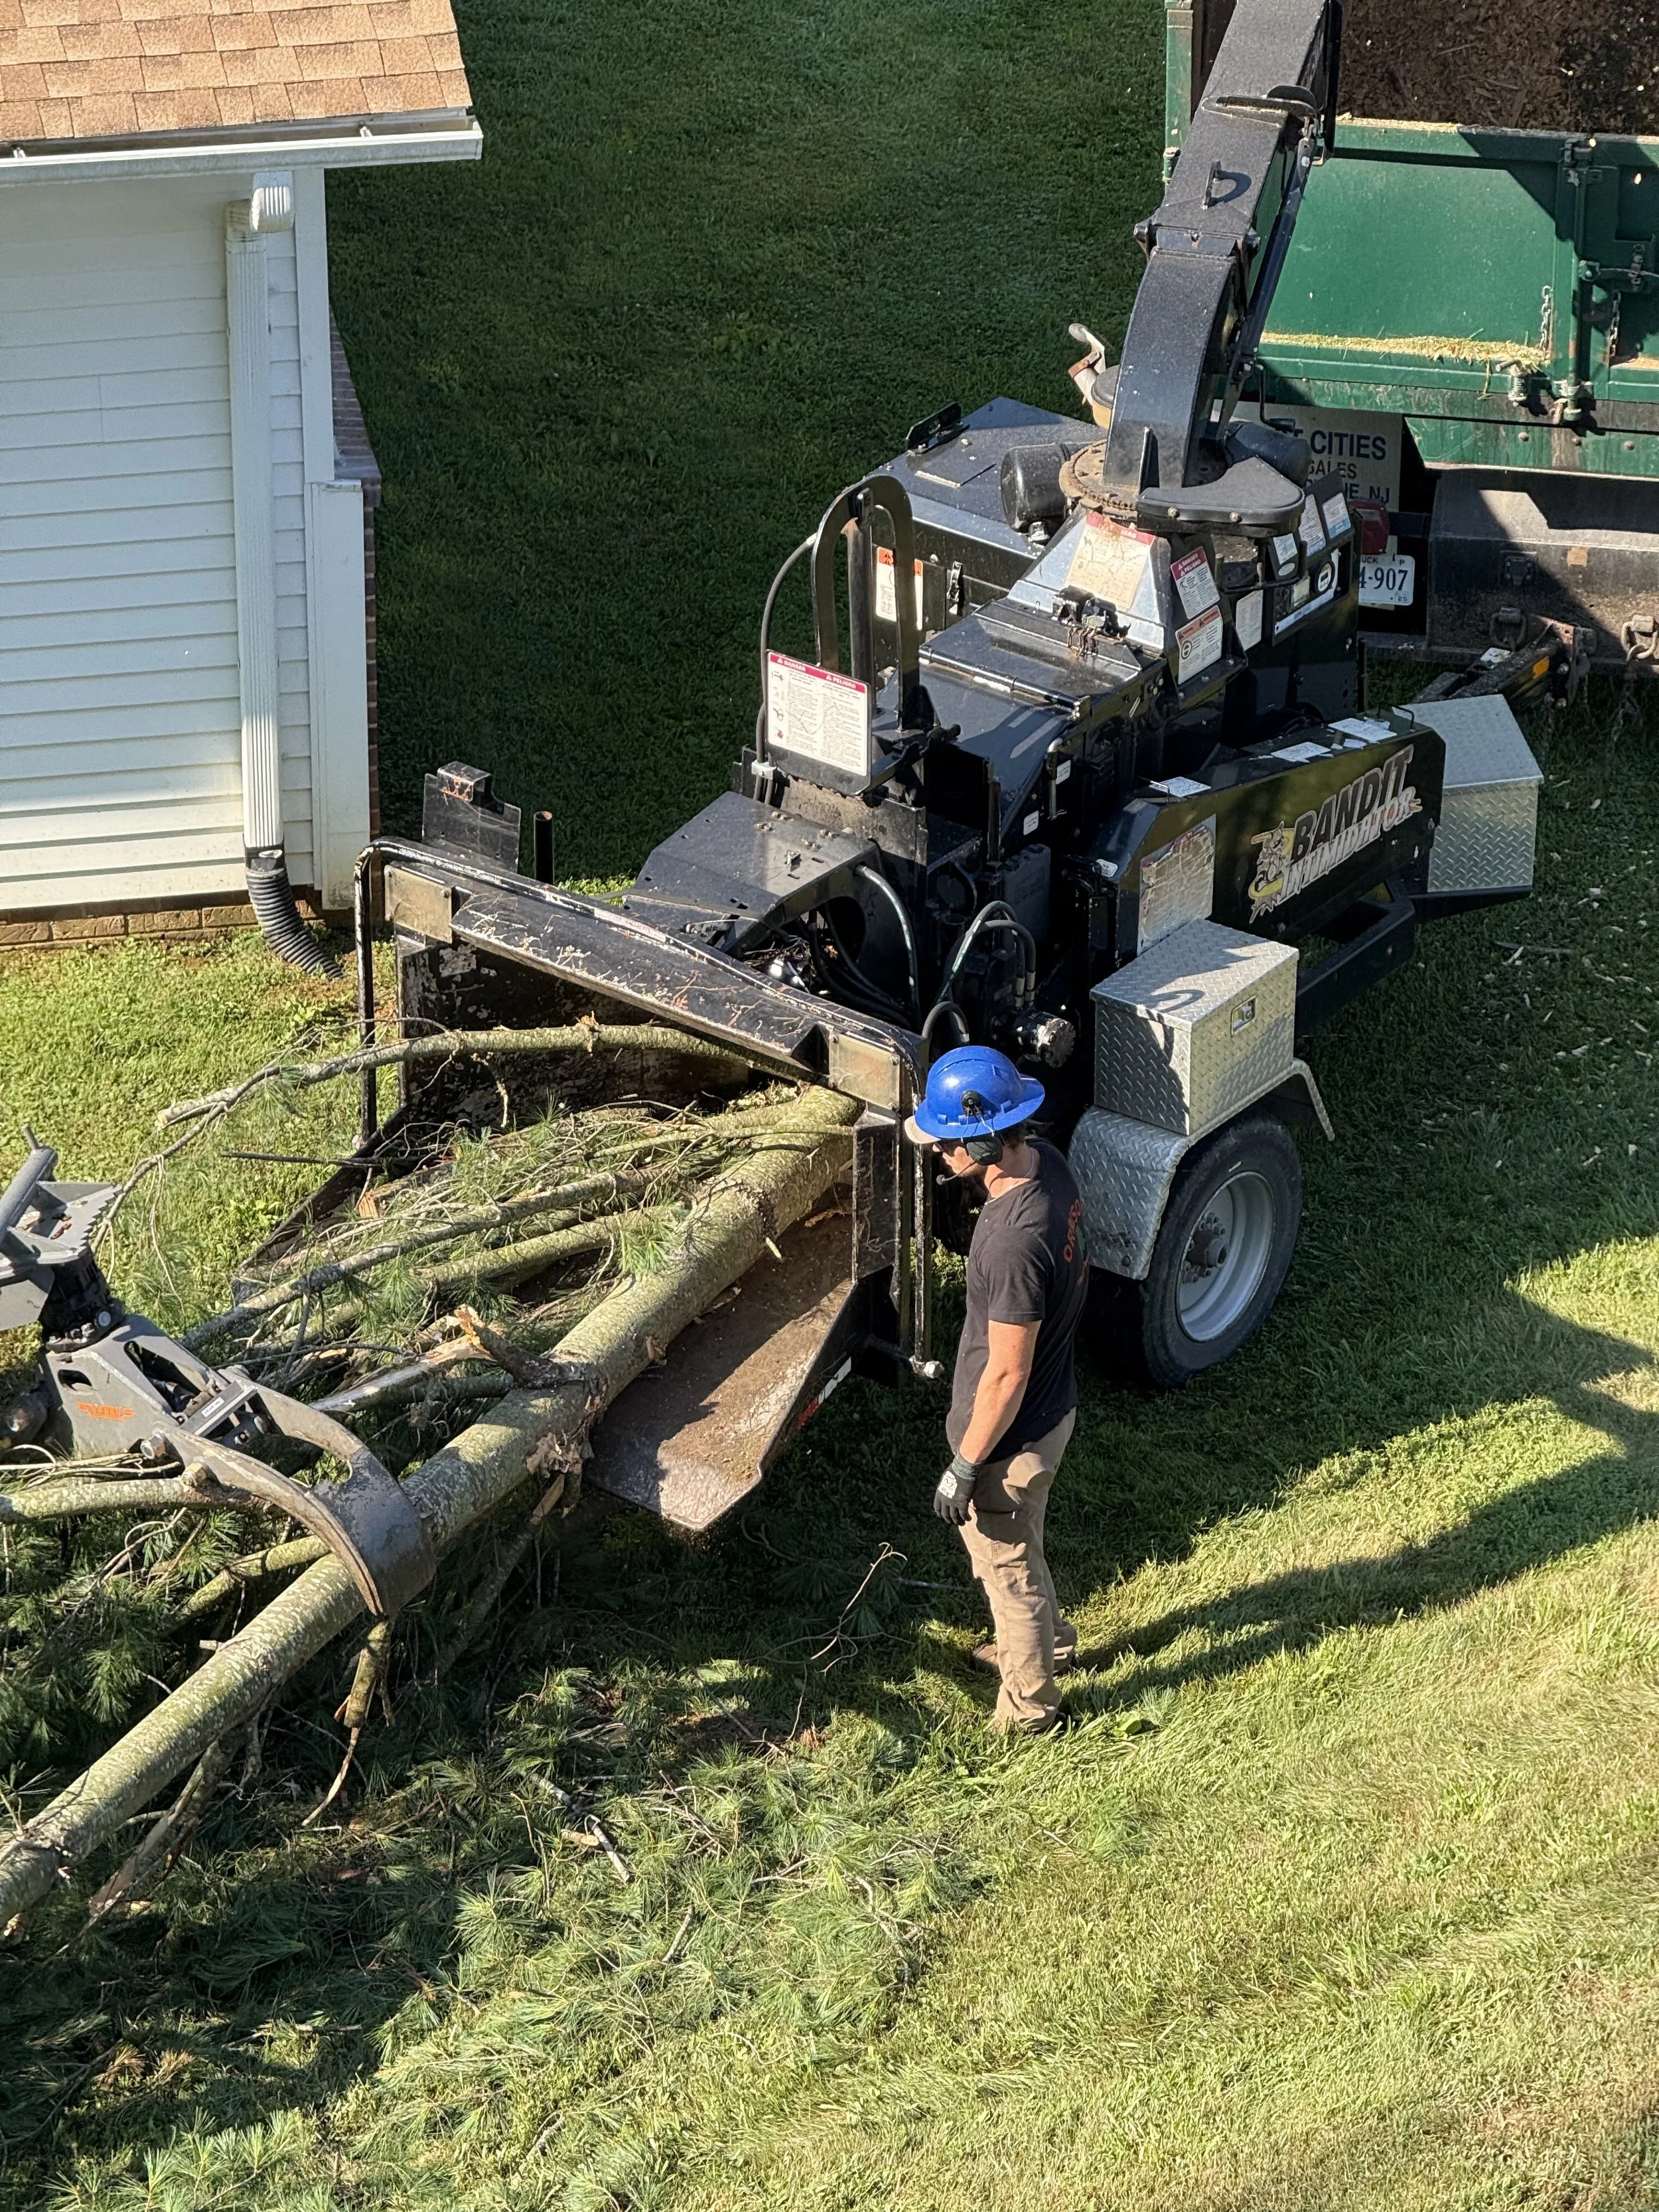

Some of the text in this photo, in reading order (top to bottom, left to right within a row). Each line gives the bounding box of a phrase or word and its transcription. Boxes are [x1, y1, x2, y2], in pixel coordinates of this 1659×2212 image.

[1310, 430, 1386, 461] CITIES
[1369, 485, 1390, 504] NJ
[1358, 566, 1408, 591] 4-907
[784, 659, 806, 672] DANGER
[832, 676, 857, 690] PELIGRO
[1290, 744, 1414, 862] BANDIT
[1275, 786, 1417, 905] INTIMIDATOR
